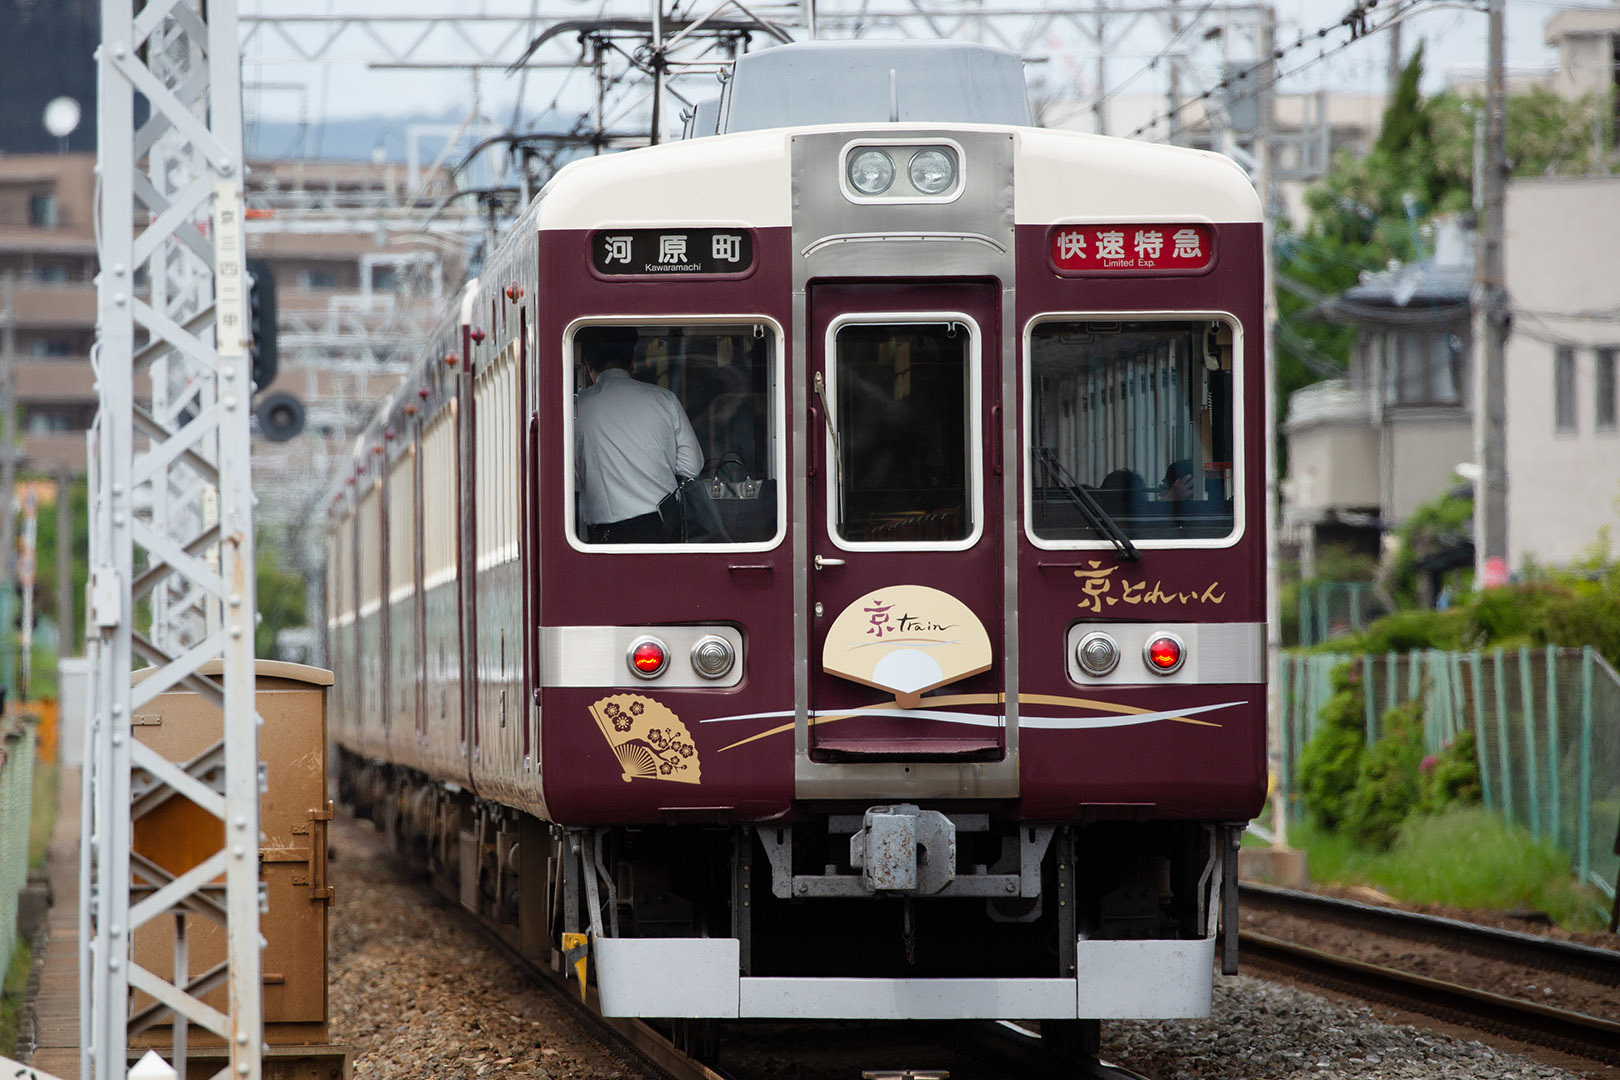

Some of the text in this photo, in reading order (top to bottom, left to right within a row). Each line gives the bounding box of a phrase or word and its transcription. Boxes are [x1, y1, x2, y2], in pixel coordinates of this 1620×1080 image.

[604, 234, 742, 264] 河原町
[1057, 229, 1202, 260] 快速特急
[645, 263, 701, 272] Kawaramachi
[1103, 259, 1156, 268] Limited Exp.
[1073, 560, 1226, 612] 京とれいん
